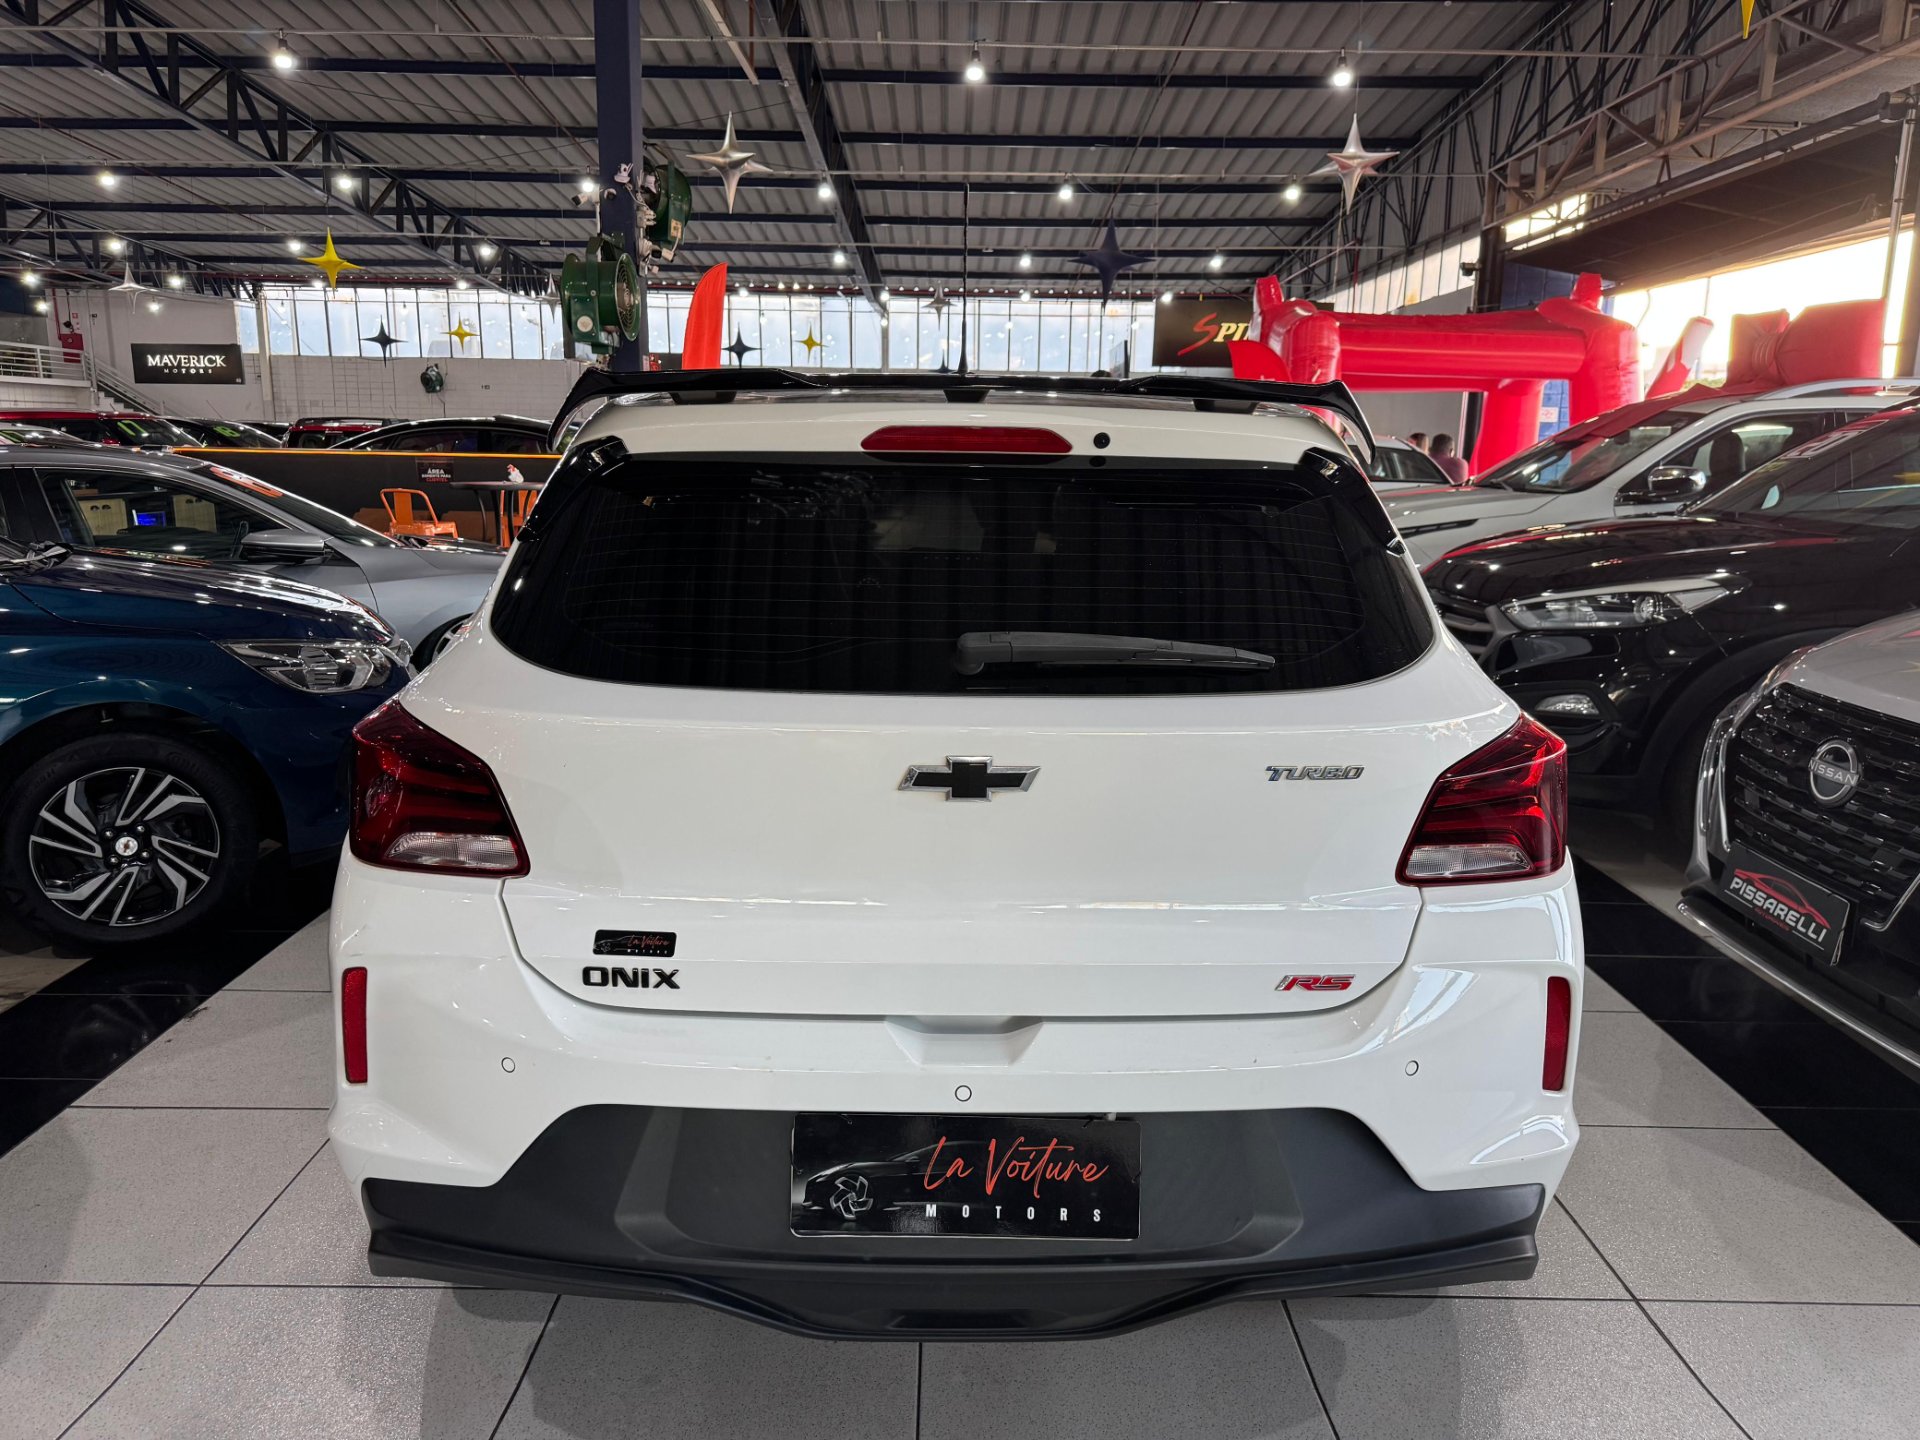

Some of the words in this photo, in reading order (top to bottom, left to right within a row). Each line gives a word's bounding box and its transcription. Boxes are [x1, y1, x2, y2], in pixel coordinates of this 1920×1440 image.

[1177, 312, 1251, 357] SPI
[146, 354, 227, 368] MAVERICK
[1265, 765, 1365, 781] TURBO
[1808, 758, 1859, 787] NISSAN
[1729, 876, 1828, 943] PISSARELLI
[582, 965, 681, 990] ONIX
[1274, 974, 1356, 992] RS
[923, 1136, 975, 1192] La
[985, 1136, 1110, 1200] Voiture
[925, 1203, 1102, 1223] MOTORS
